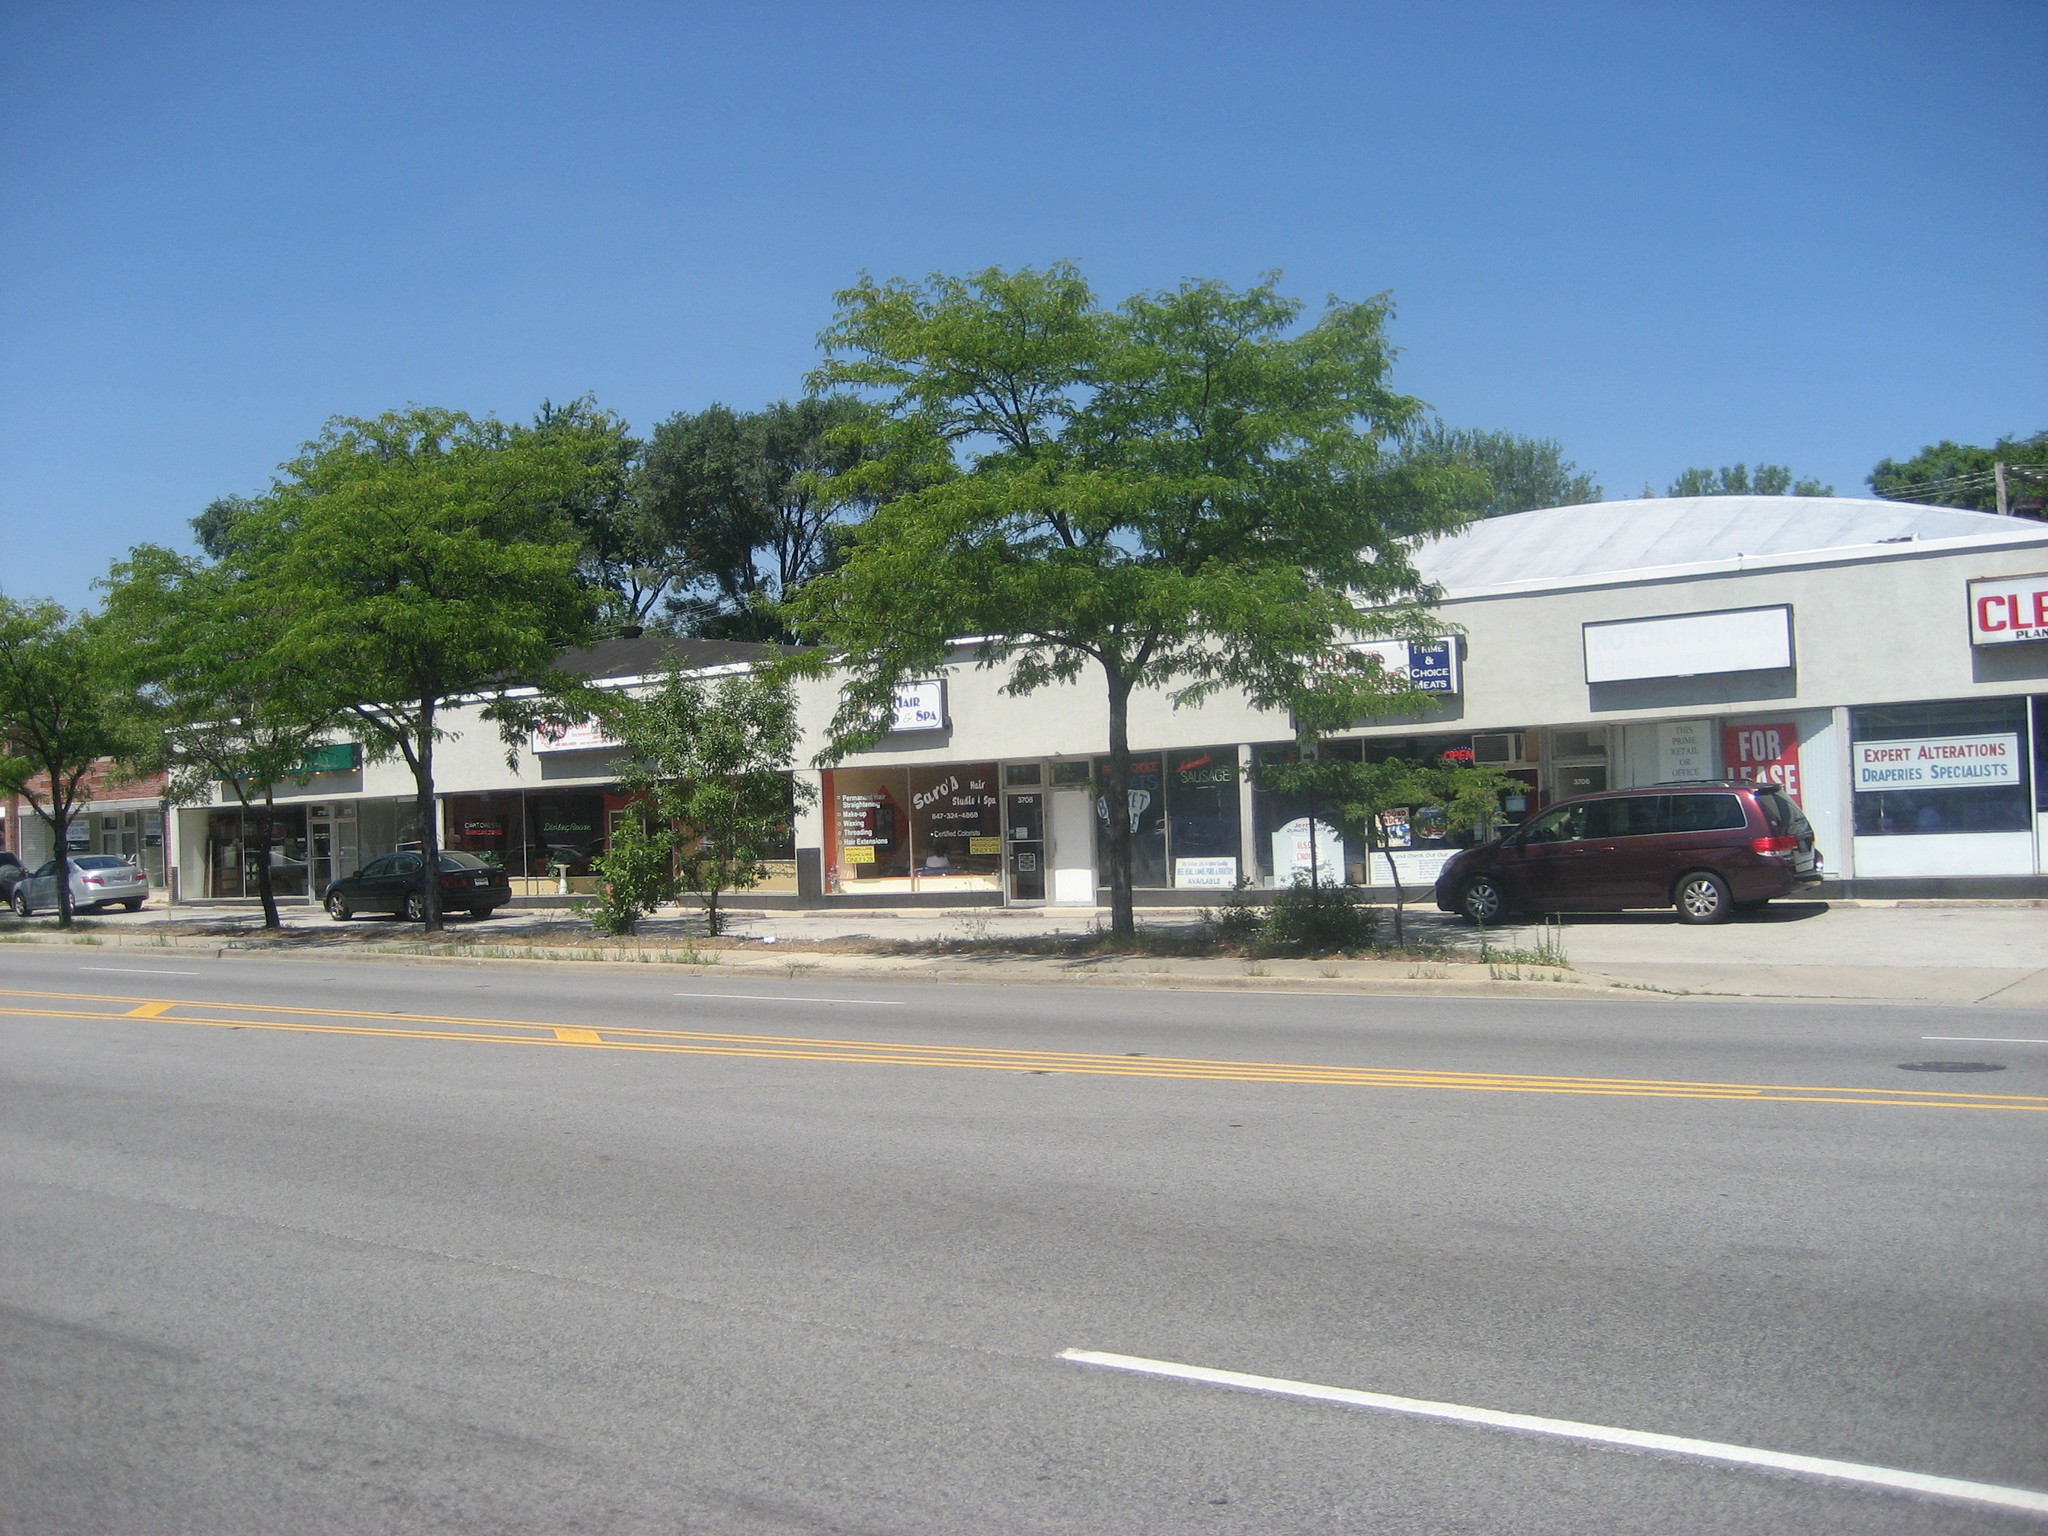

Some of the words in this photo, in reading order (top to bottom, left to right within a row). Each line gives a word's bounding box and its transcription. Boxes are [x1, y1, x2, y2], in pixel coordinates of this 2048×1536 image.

[1977, 590, 2048, 632] CLE
[1424, 656, 1434, 665] &
[1411, 668, 1449, 678] CHOICE
[915, 711, 937, 722] SPA
[1676, 726, 1693, 735] THIS
[1672, 736, 1697, 745] PRIME
[1738, 729, 1782, 762] FOR
[1443, 749, 1475, 761] OPEN
[1671, 747, 1698, 755] RETAIL
[1863, 748, 1911, 763] EXPERT
[1917, 743, 2007, 760] ALTERATIONS
[1679, 758, 1691, 766] OR
[1180, 767, 1231, 783] SAUSAGE
[1671, 768, 1699, 777] OFFICE
[1862, 768, 1922, 783] DRAPERIES
[1930, 763, 2009, 779] SPECIALISTS
[970, 780, 986, 789] Hair
[952, 796, 975, 806] Studio
[983, 795, 997, 807] Spa
[843, 811, 867, 819] Make-up
[843, 820, 865, 828] Waxing
[844, 829, 873, 837] Threading
[856, 837, 889, 845] Extensions
